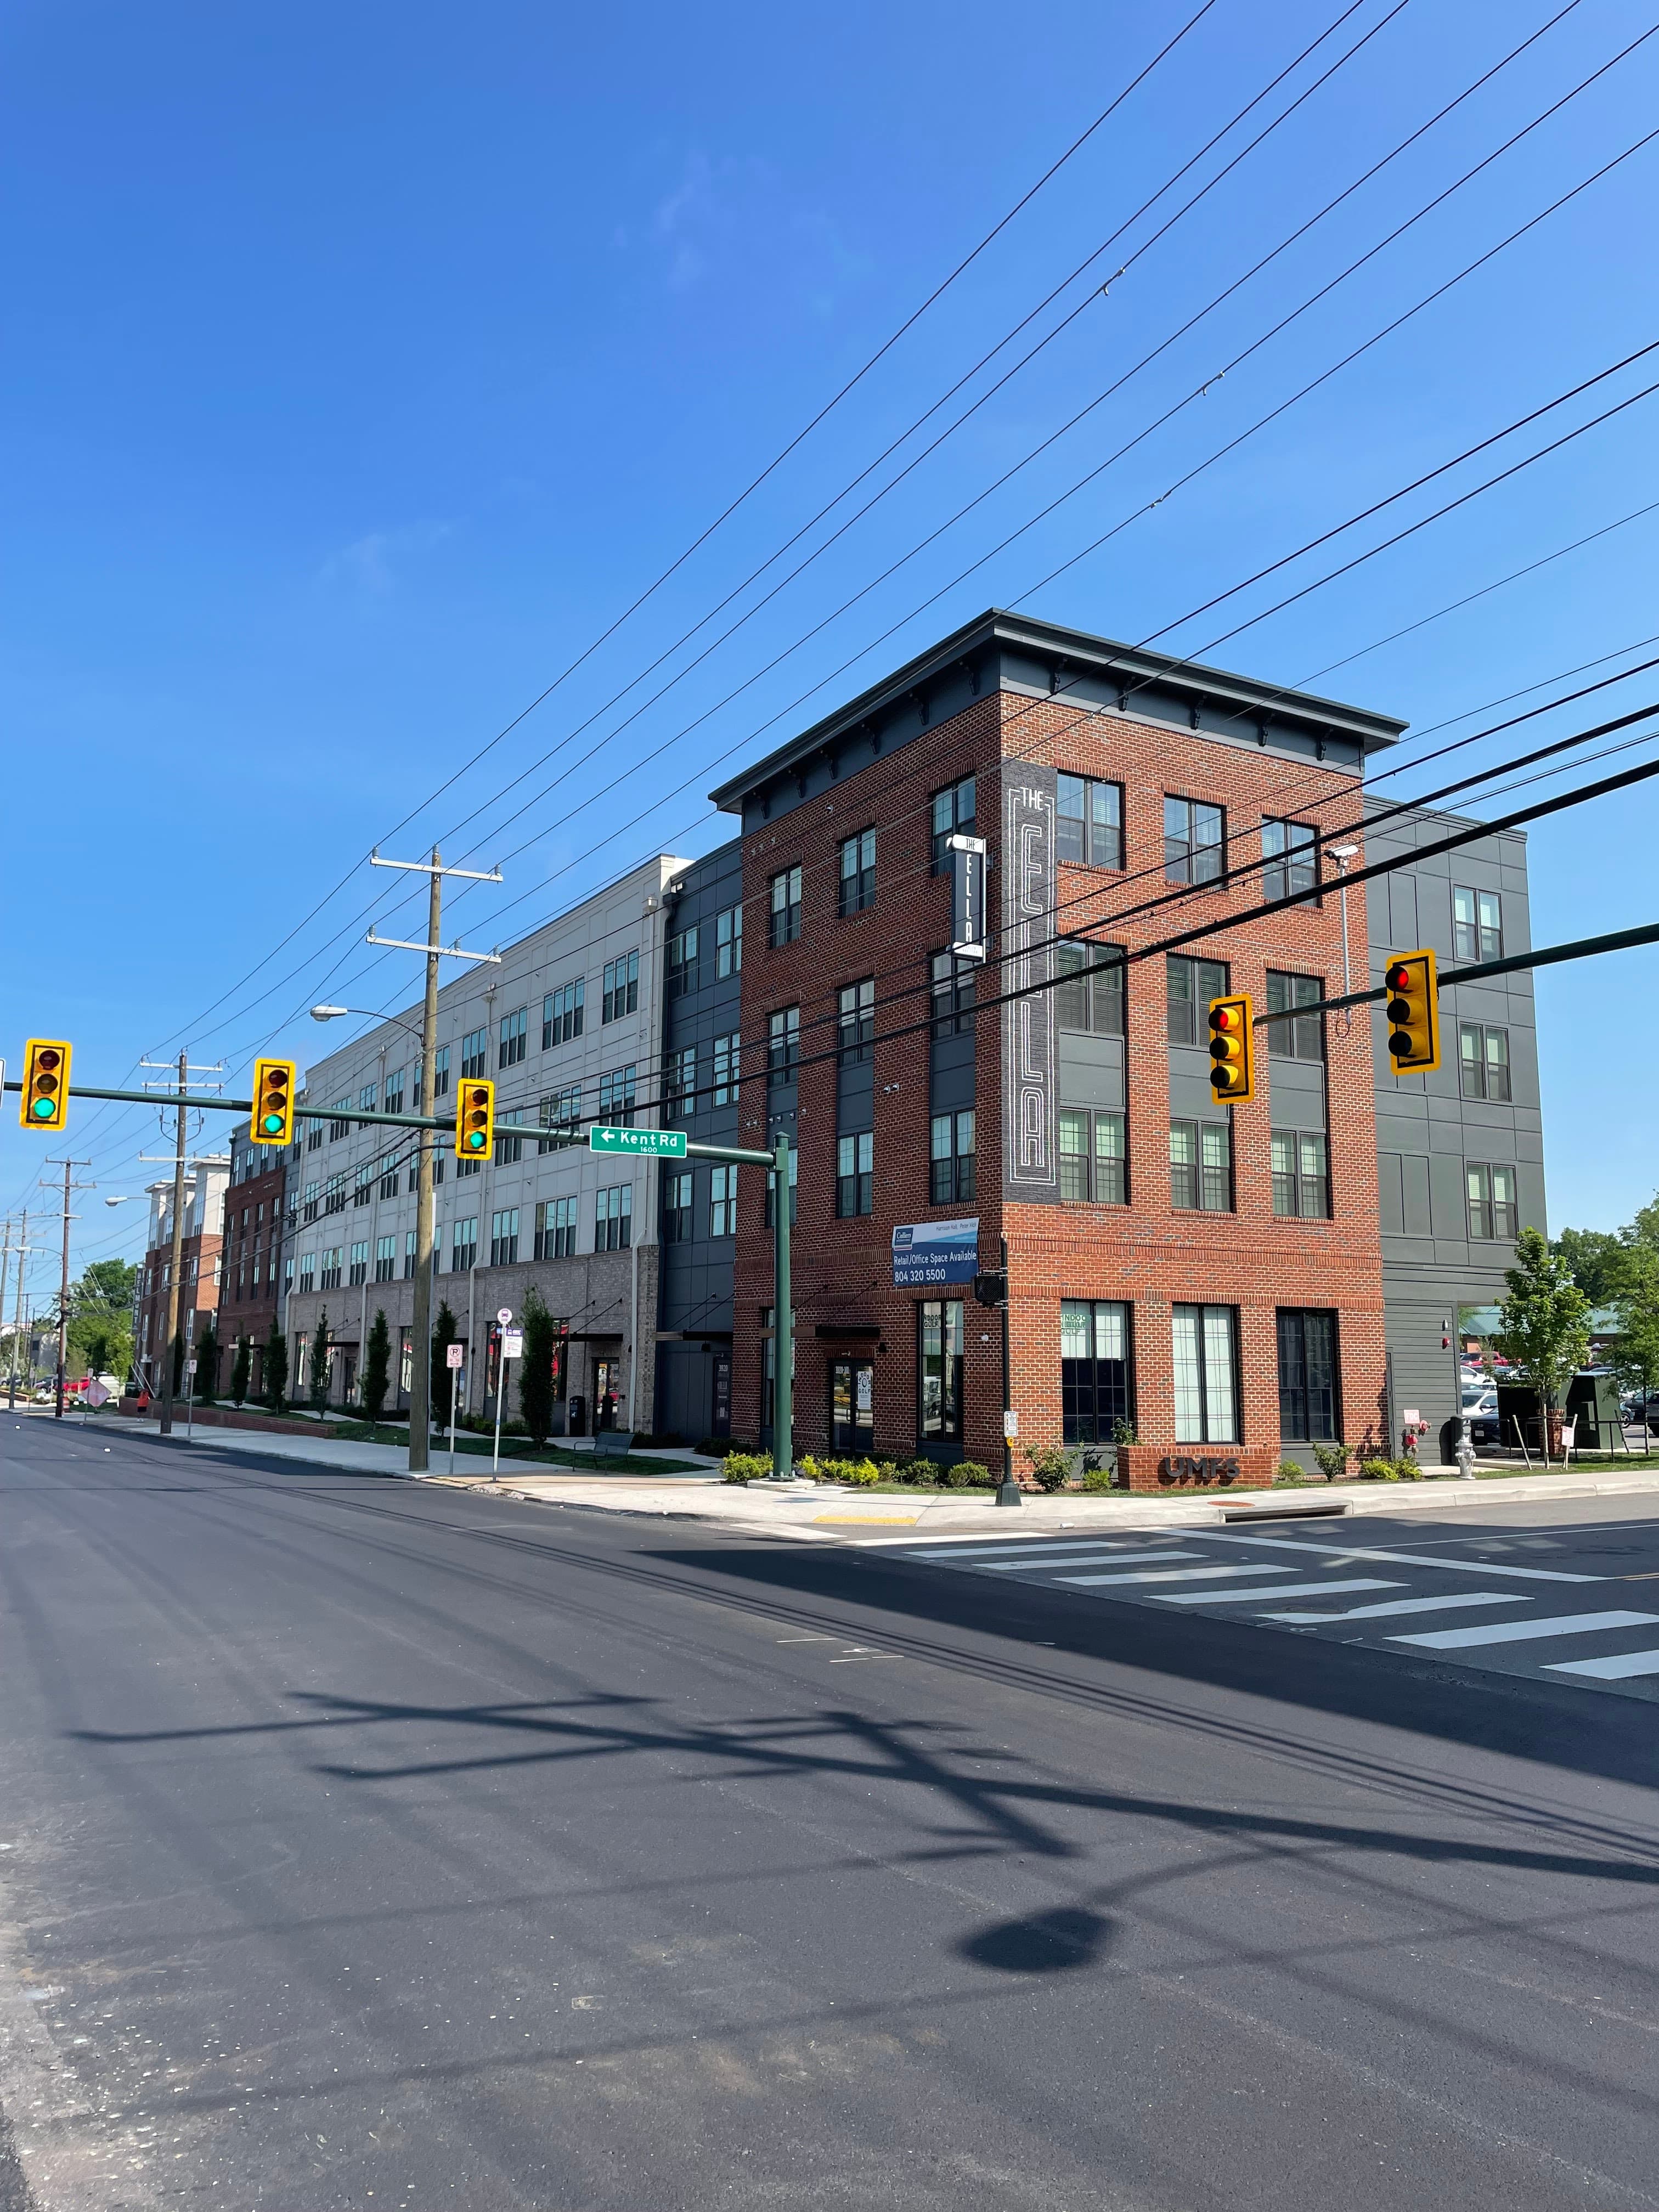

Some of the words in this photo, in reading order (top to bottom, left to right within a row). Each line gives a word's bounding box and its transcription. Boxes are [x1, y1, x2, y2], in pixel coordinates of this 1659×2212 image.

[1019, 787, 1045, 811] THE
[966, 838, 975, 850] THE
[620, 1131, 656, 1146] Kent
[659, 1135, 678, 1147] Rd
[894, 1254, 929, 1266] Retail/Office
[930, 1253, 948, 1265] Space
[949, 1250, 977, 1262] Available
[895, 1271, 909, 1282] 804
[910, 1269, 924, 1282] 320
[926, 1268, 946, 1280] 5500
[857, 1372, 871, 1385] INDOOR
[1165, 1457, 1240, 1477] UMFS
